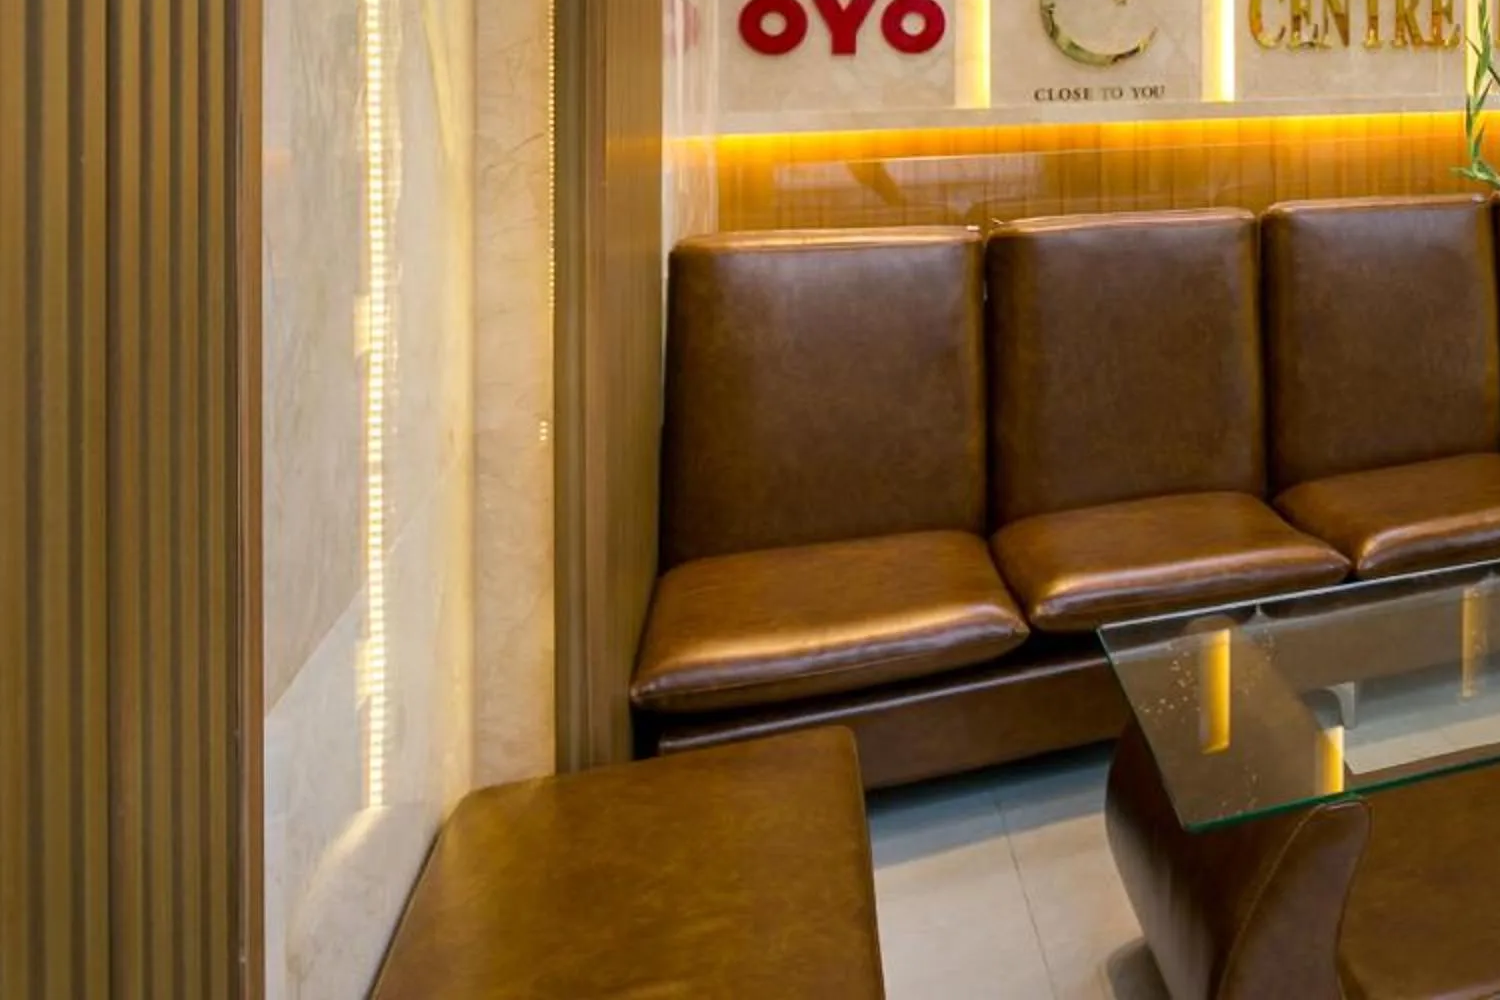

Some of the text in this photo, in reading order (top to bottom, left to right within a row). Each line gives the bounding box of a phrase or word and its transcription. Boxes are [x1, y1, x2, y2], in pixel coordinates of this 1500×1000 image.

[1033, 84, 1166, 102] CLOSE TO YOU
